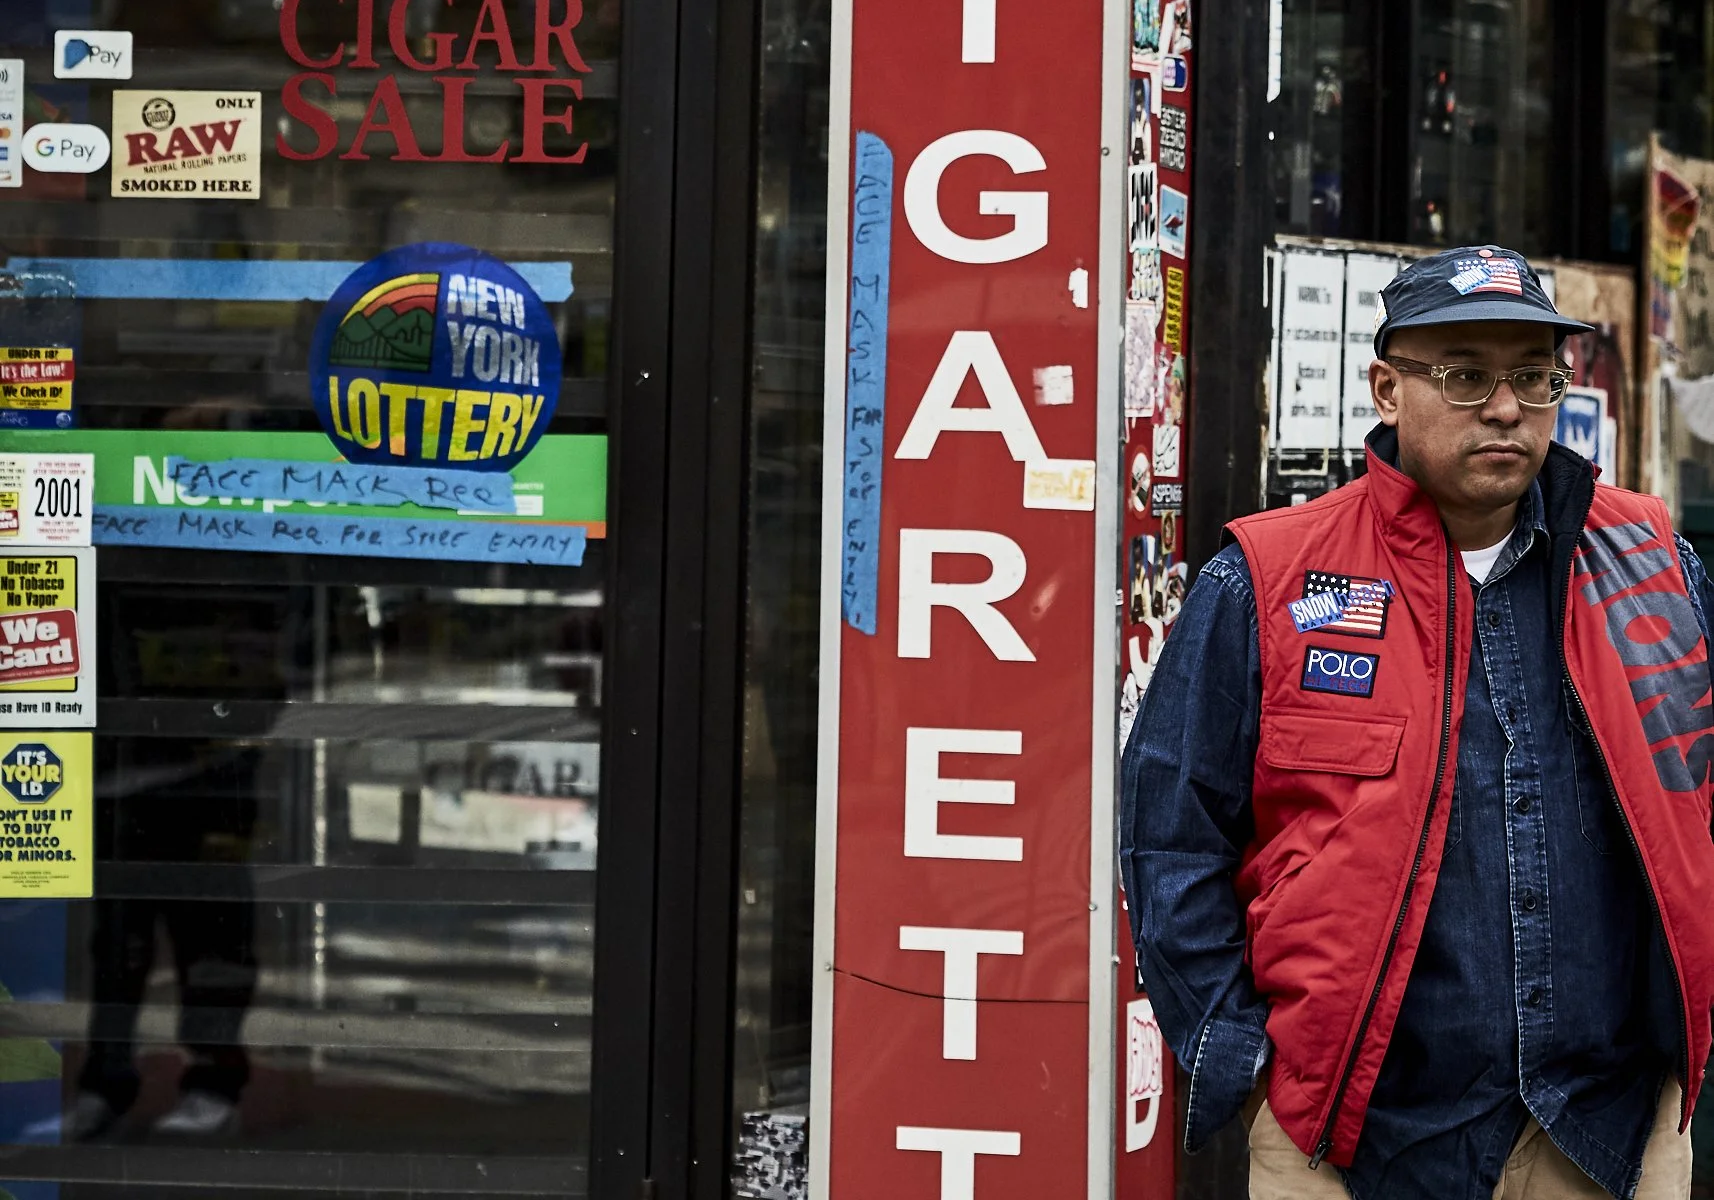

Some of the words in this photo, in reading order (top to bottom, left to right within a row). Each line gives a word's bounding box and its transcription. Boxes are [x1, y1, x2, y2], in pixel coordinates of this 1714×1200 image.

[215, 98, 256, 109] ONLY
[276, 72, 588, 164] SALE
[60, 140, 96, 162] Pay
[124, 119, 242, 166] RAW
[143, 159, 178, 173] NATURAL
[181, 156, 214, 169] ROLLING
[217, 153, 248, 165] PAPERS
[121, 179, 197, 192] SMOKED
[202, 180, 252, 192] HERE
[446, 274, 525, 330] NEW
[851, 273, 880, 386] MASK
[8, 348, 41, 360] UNDER
[446, 321, 540, 387] YORK
[20, 362, 37, 378] the
[40, 362, 65, 377] Law!
[2, 385, 18, 398] We
[20, 386, 47, 398] Check
[329, 375, 544, 461] LOTTERY
[168, 462, 259, 496] FACE
[281, 463, 408, 499] MASK
[35, 477, 82, 518] 2001
[92, 512, 149, 535] FACE
[178, 511, 256, 540] MASK
[7, 560, 41, 575] Under
[45, 560, 58, 574] 21
[1, 576, 16, 590] No
[19, 576, 65, 590] Tobacco
[7, 592, 22, 606] No
[26, 592, 58, 608] Vapor
[1291, 591, 1339, 624] SNOW
[1301, 613, 1343, 630] RALPH
[1, 617, 60, 645] We
[1307, 649, 1373, 679] POLO
[1328, 676, 1369, 693] TECH
[16, 702, 38, 713] Have
[41, 702, 51, 713] ID
[55, 702, 83, 716] Ready
[16, 750, 47, 766] IT'S
[2, 764, 61, 782] YOUR
[20, 781, 45, 796] I.D.
[32, 809, 56, 821] USE
[61, 809, 73, 821] IT
[3, 823, 21, 835] TO
[25, 823, 52, 834] BUY
[0, 836, 60, 848] TOBACCO
[18, 850, 76, 861] MINORS.
